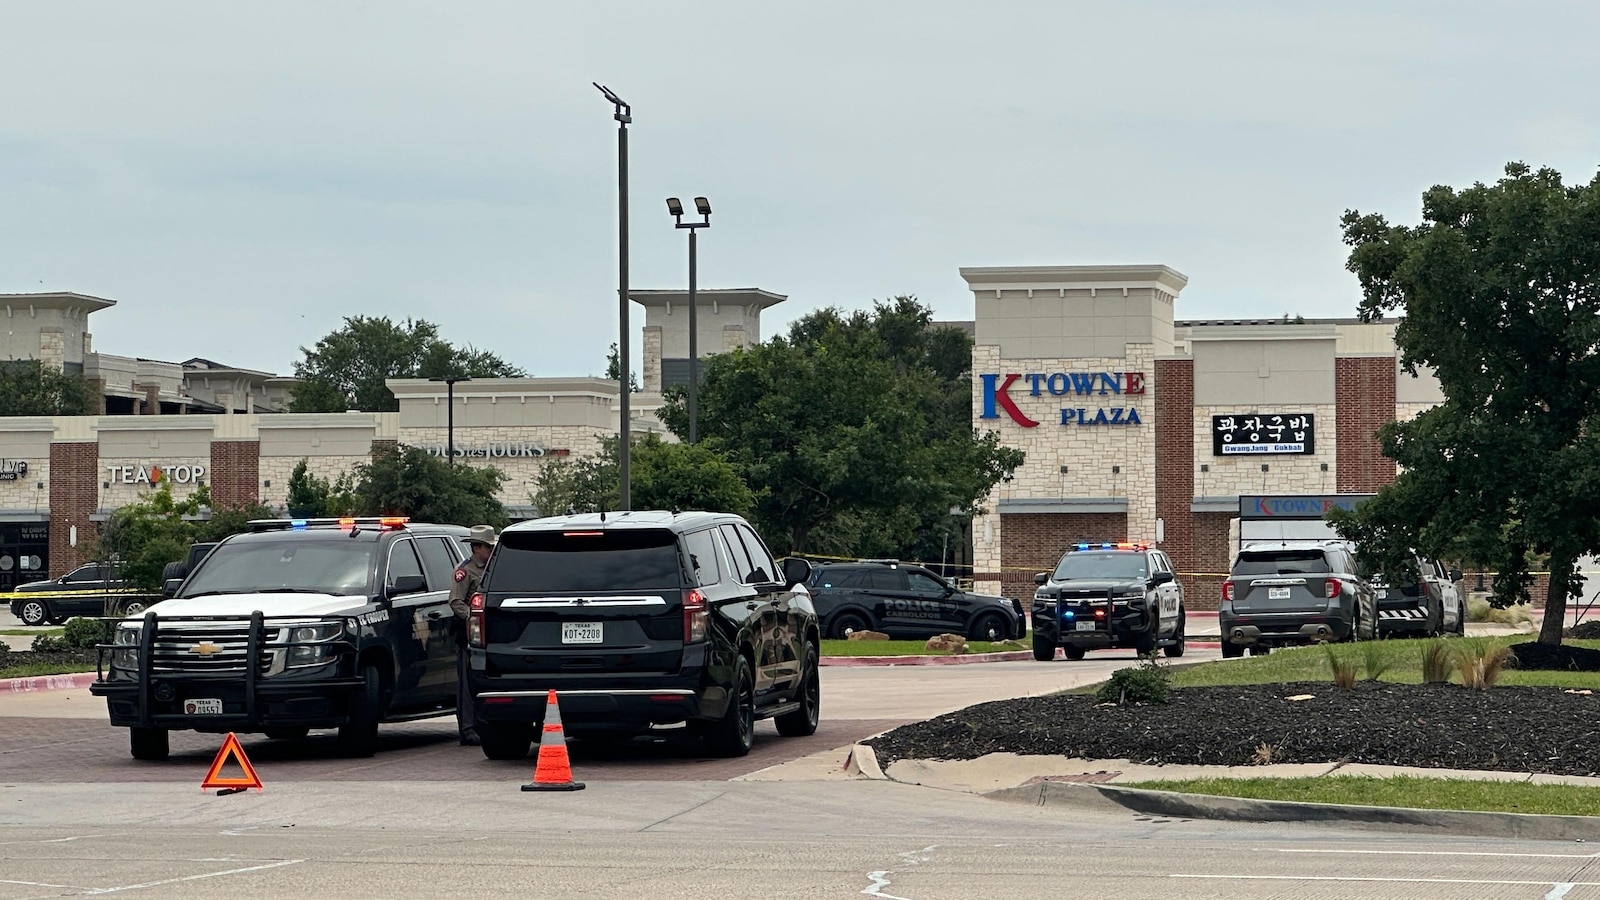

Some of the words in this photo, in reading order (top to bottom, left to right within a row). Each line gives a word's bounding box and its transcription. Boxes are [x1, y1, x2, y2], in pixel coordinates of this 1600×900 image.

[979, 373, 1040, 428] K
[1025, 372, 1145, 396] TOWNE
[1060, 407, 1142, 425] PLAZA
[1217, 416, 1309, 442] 광장국밥
[412, 441, 465, 458] OUS
[485, 441, 545, 460] JOURS
[107, 466, 150, 484] TEA
[162, 465, 205, 484] TOP
[1254, 497, 1273, 515] K
[884, 599, 940, 611] POLICE
[886, 611, 941, 619] CARROLLTON
